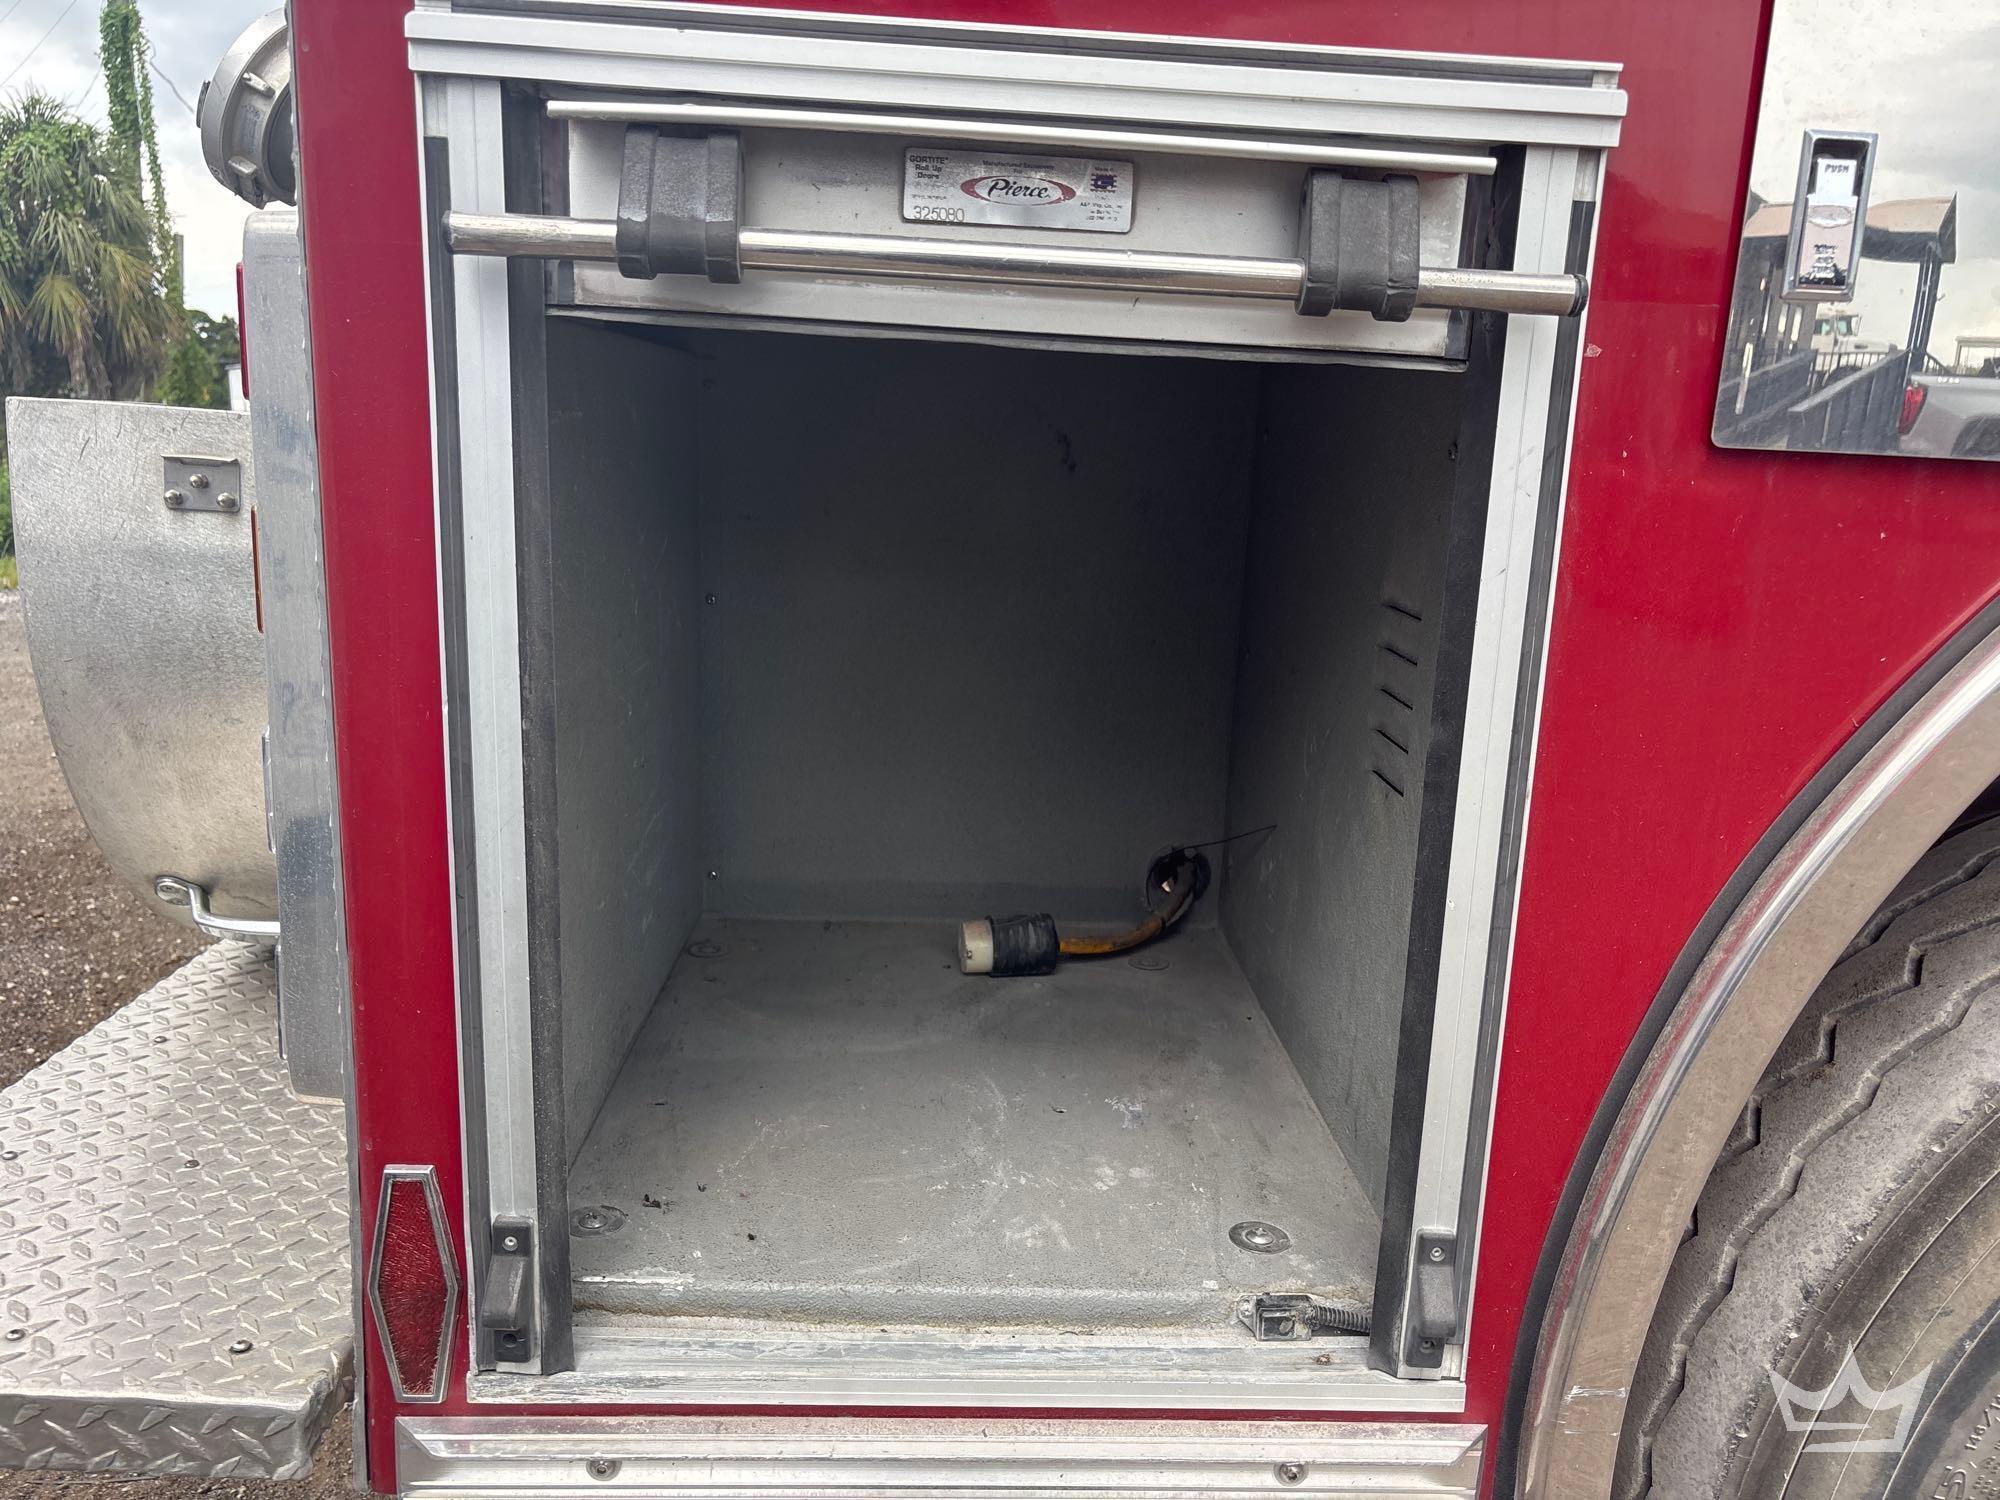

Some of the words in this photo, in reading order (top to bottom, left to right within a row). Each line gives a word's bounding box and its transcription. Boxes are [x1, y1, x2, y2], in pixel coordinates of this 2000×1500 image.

[915, 163, 929, 172] Roll
[1824, 163, 1850, 174] PUSH
[987, 178, 1048, 199] Pierce
[913, 205, 965, 222] 325080
